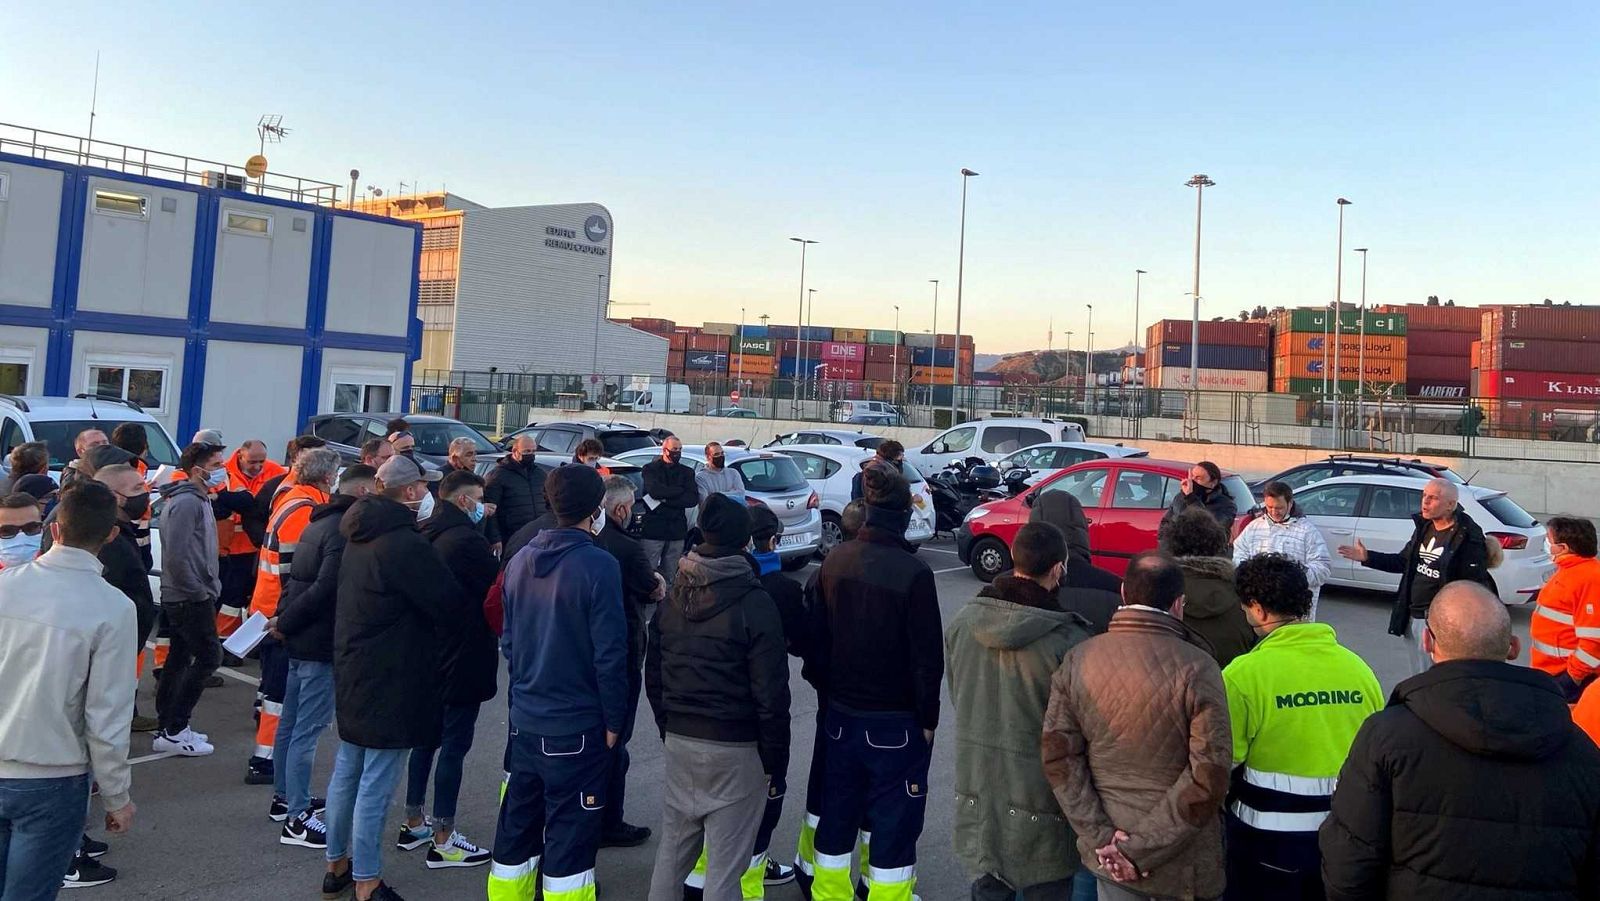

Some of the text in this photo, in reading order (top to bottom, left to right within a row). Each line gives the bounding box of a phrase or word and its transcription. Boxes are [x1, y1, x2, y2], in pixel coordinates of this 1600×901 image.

[740, 341, 765, 349] UASC
[831, 344, 856, 356] ONE
[1548, 381, 1563, 393] K
[1276, 690, 1363, 709] MOORING
